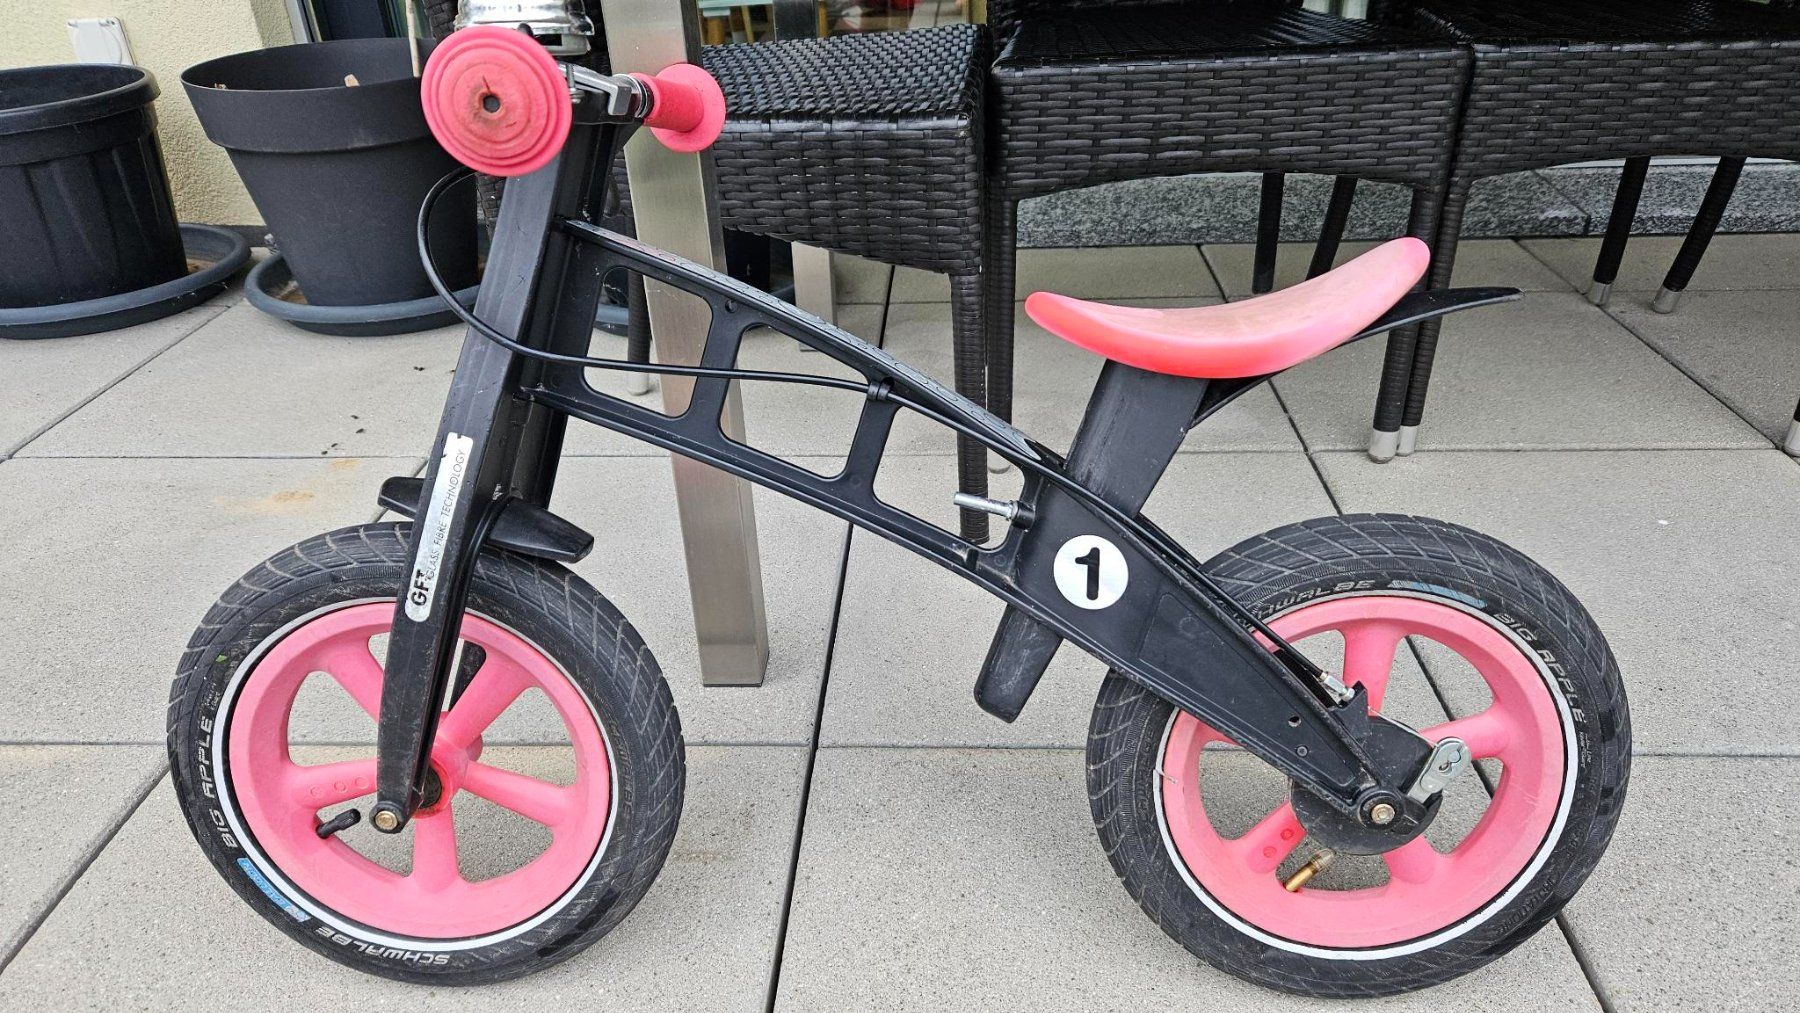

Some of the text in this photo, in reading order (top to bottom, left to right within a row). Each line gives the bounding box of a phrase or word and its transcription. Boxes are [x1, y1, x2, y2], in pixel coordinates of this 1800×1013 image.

[427, 450, 466, 580] GLASS FIBRE TECHNOLOGY
[1075, 547, 1100, 600] 1
[1493, 612, 1588, 724] BIG APPLE
[197, 715, 217, 799] APPLE
[208, 808, 239, 849] BIG
[313, 925, 451, 966] SCHWALBE
